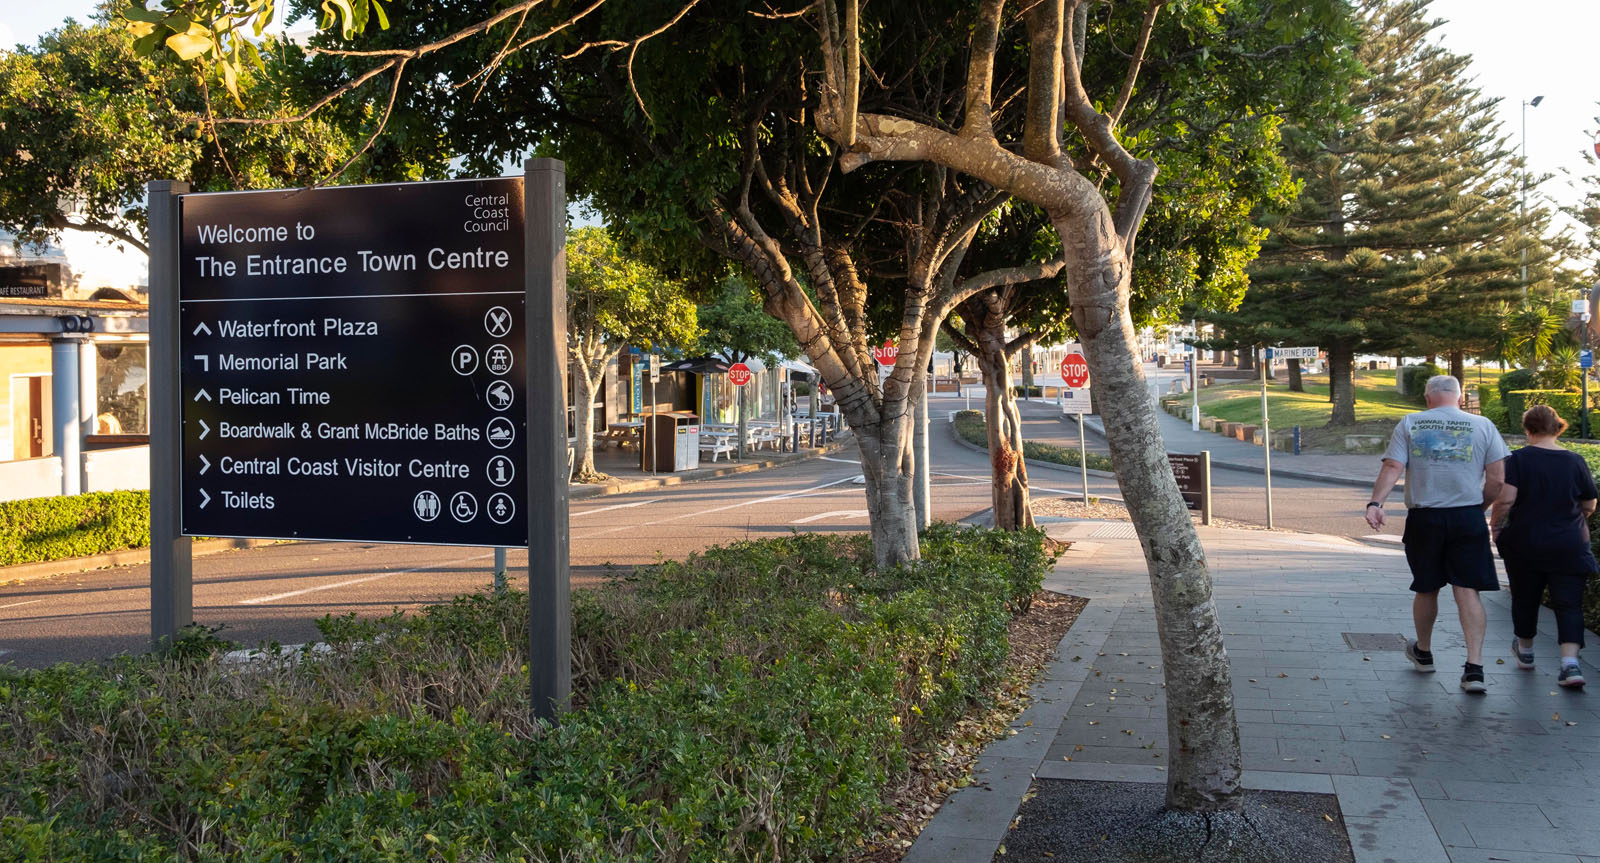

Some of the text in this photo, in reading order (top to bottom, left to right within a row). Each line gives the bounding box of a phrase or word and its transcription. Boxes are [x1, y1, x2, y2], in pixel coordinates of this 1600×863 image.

[464, 192, 509, 207] Central
[473, 206, 509, 219] Coast
[196, 221, 315, 245] Welcome to
[463, 218, 509, 233] Council
[195, 247, 509, 277] The Entrance Town Centre
[0, 285, 45, 296] AFÉ RESTAURANT
[217, 318, 378, 338] Waterfront Plaza
[876, 346, 898, 357] STOP
[1274, 348, 1317, 357] MARINE PDE
[219, 352, 347, 371] Memorial Park
[460, 352, 472, 369] P
[730, 370, 750, 379] STOP
[1063, 363, 1087, 377] STOP
[219, 387, 331, 405] Pelican Time
[220, 422, 480, 441] Boardwalk & Grant McBride Baths
[220, 456, 470, 478] Central Coast Visitor Centre
[221, 490, 276, 510] Toilets
